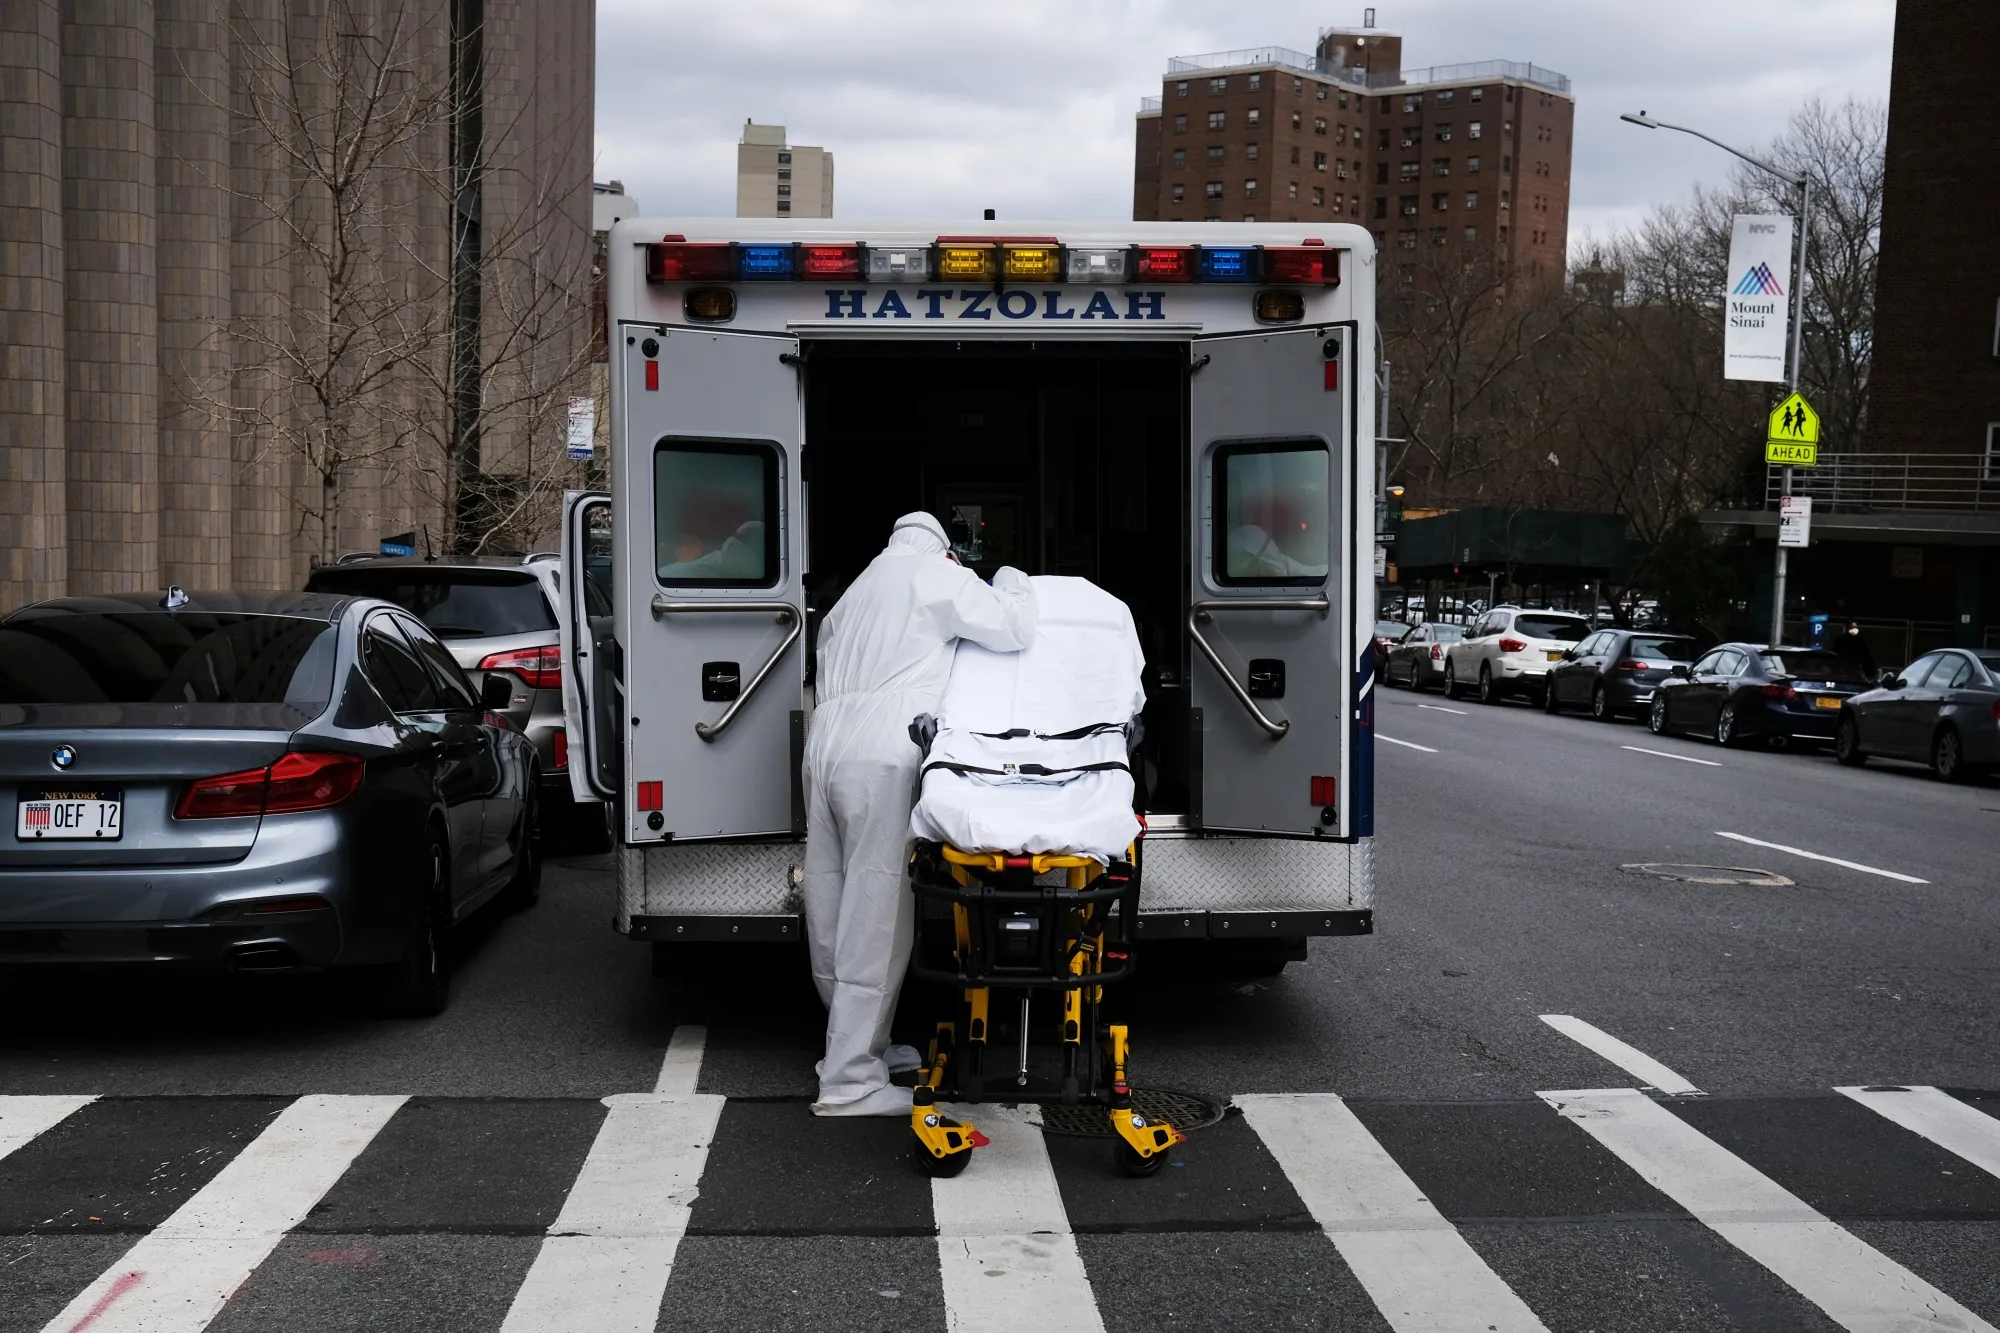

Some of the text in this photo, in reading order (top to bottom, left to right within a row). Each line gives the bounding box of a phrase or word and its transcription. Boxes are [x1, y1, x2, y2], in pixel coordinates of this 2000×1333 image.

[1748, 223, 1776, 235] NYC
[825, 289, 1166, 320] HATZOLAH
[1730, 302, 1775, 314] Mount
[1730, 315, 1765, 328] Sinai
[1772, 447, 1810, 460] AHEAD
[1814, 623, 1822, 634] P
[44, 792, 98, 800] NEW YORK
[99, 803, 117, 828] 12
